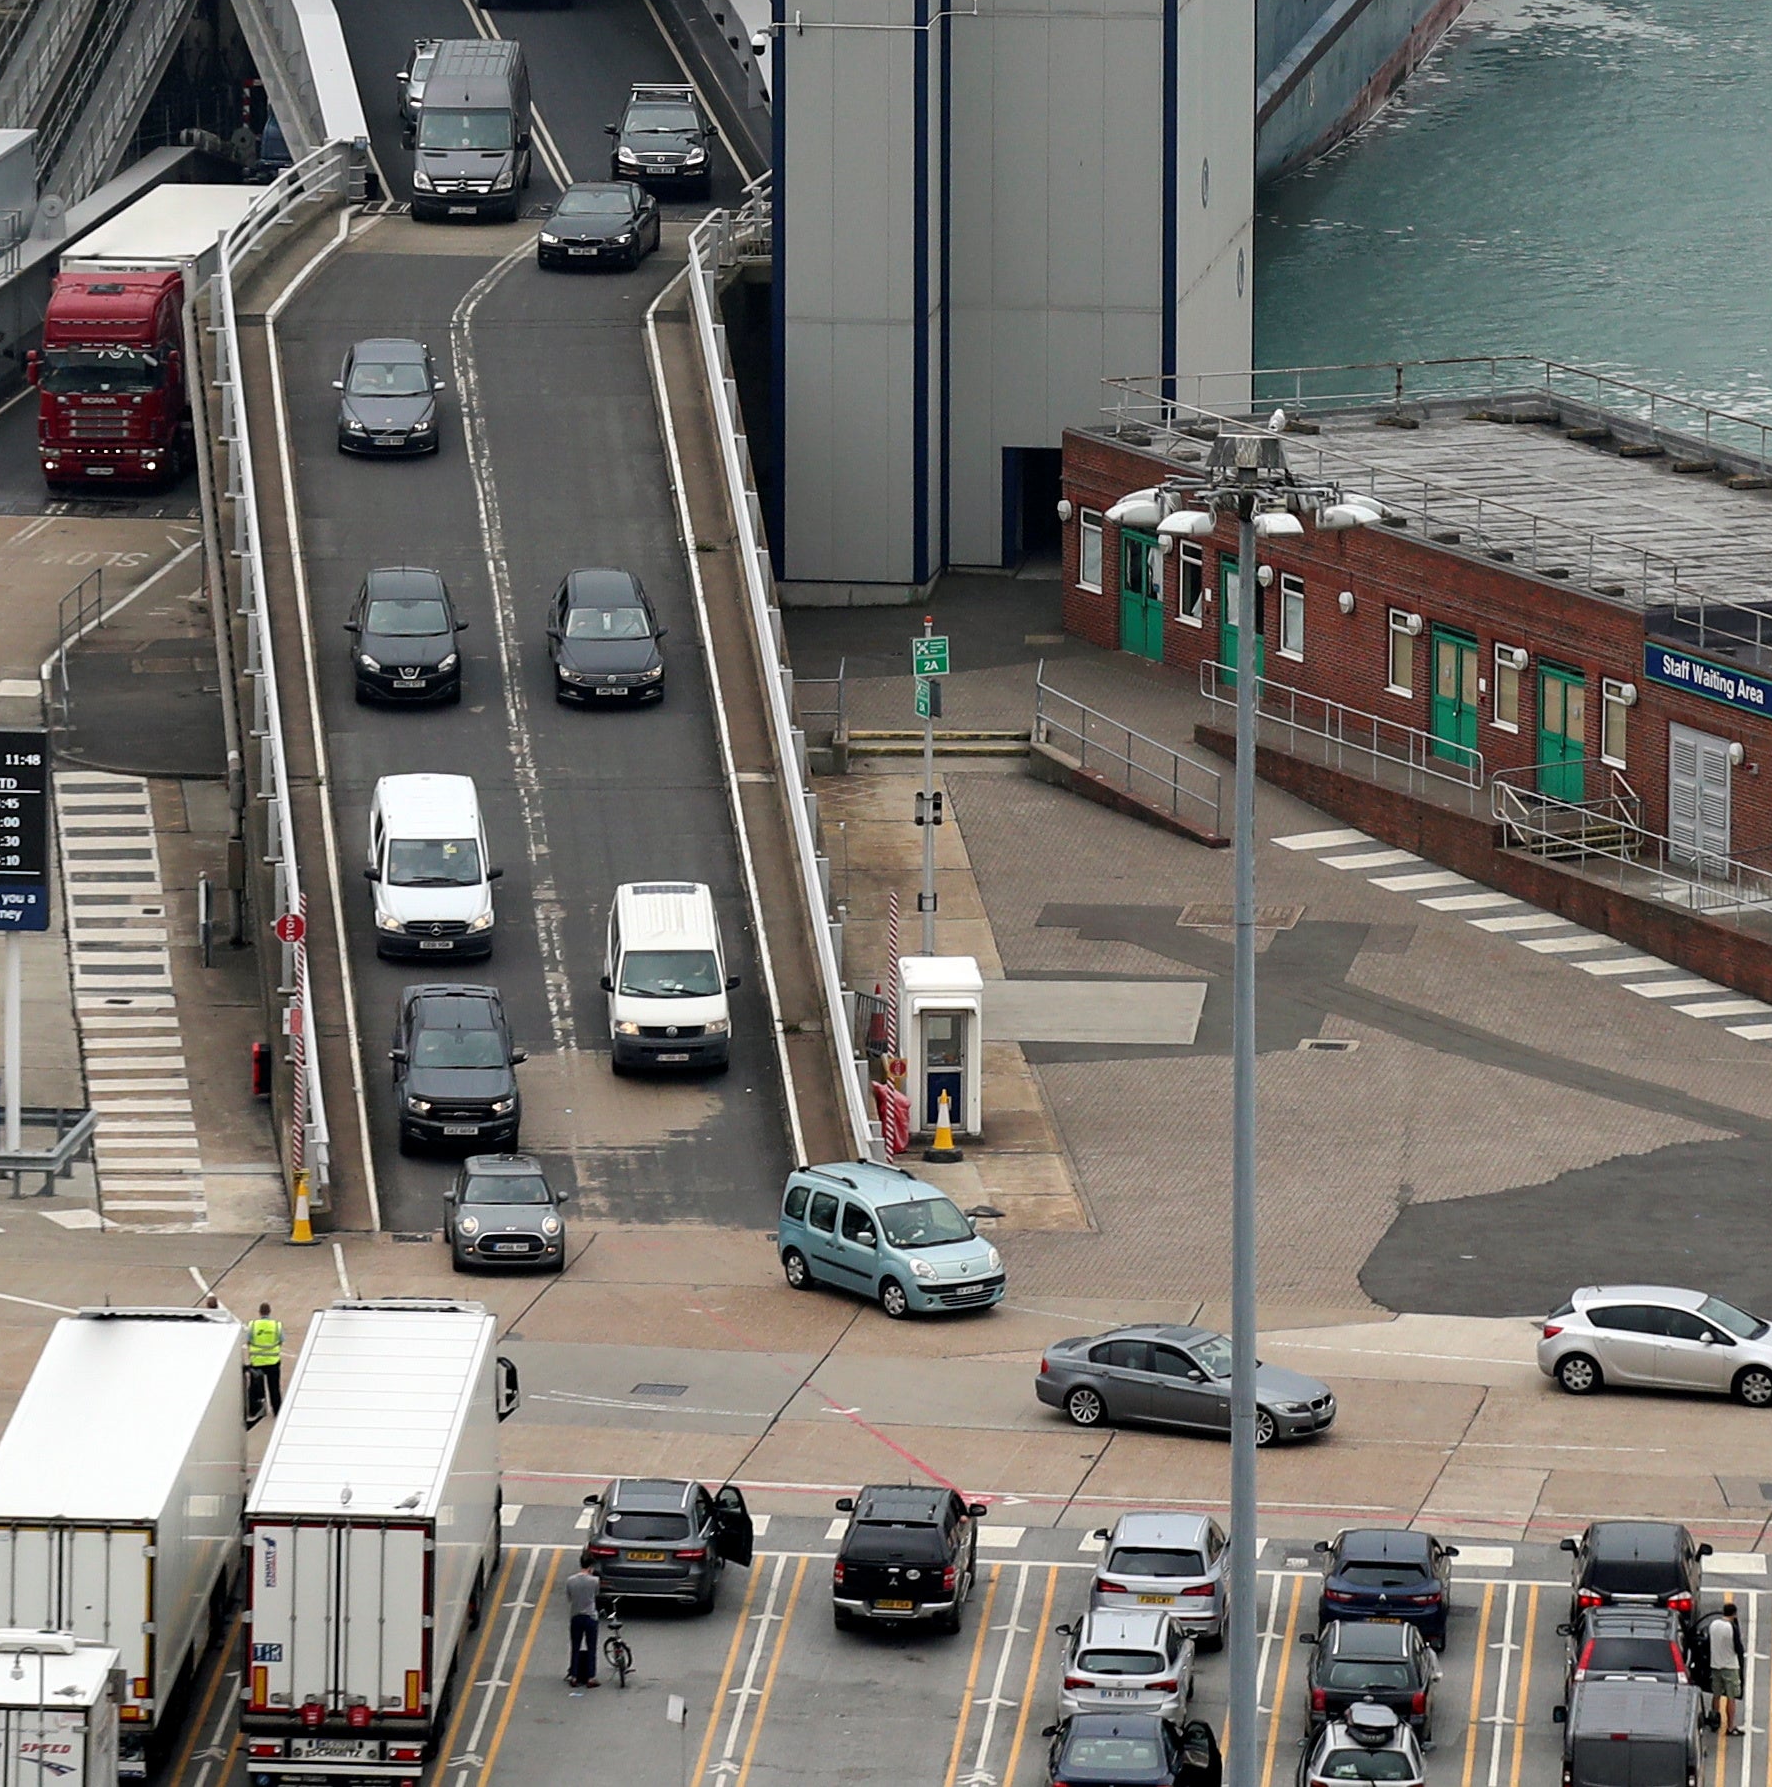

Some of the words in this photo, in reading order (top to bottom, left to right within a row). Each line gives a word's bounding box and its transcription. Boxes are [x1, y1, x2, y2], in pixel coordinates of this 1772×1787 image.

[81, 397, 117, 405] SCANIA
[1662, 654, 1691, 681] Staff
[1692, 662, 1735, 700] Waiting
[1736, 678, 1764, 705] Area
[5, 754, 41, 766] 11:48
[1, 894, 24, 905] you
[27, 895, 37, 904] a
[285, 914, 296, 941] STOP
[20, 1743, 72, 1754] SPEED
